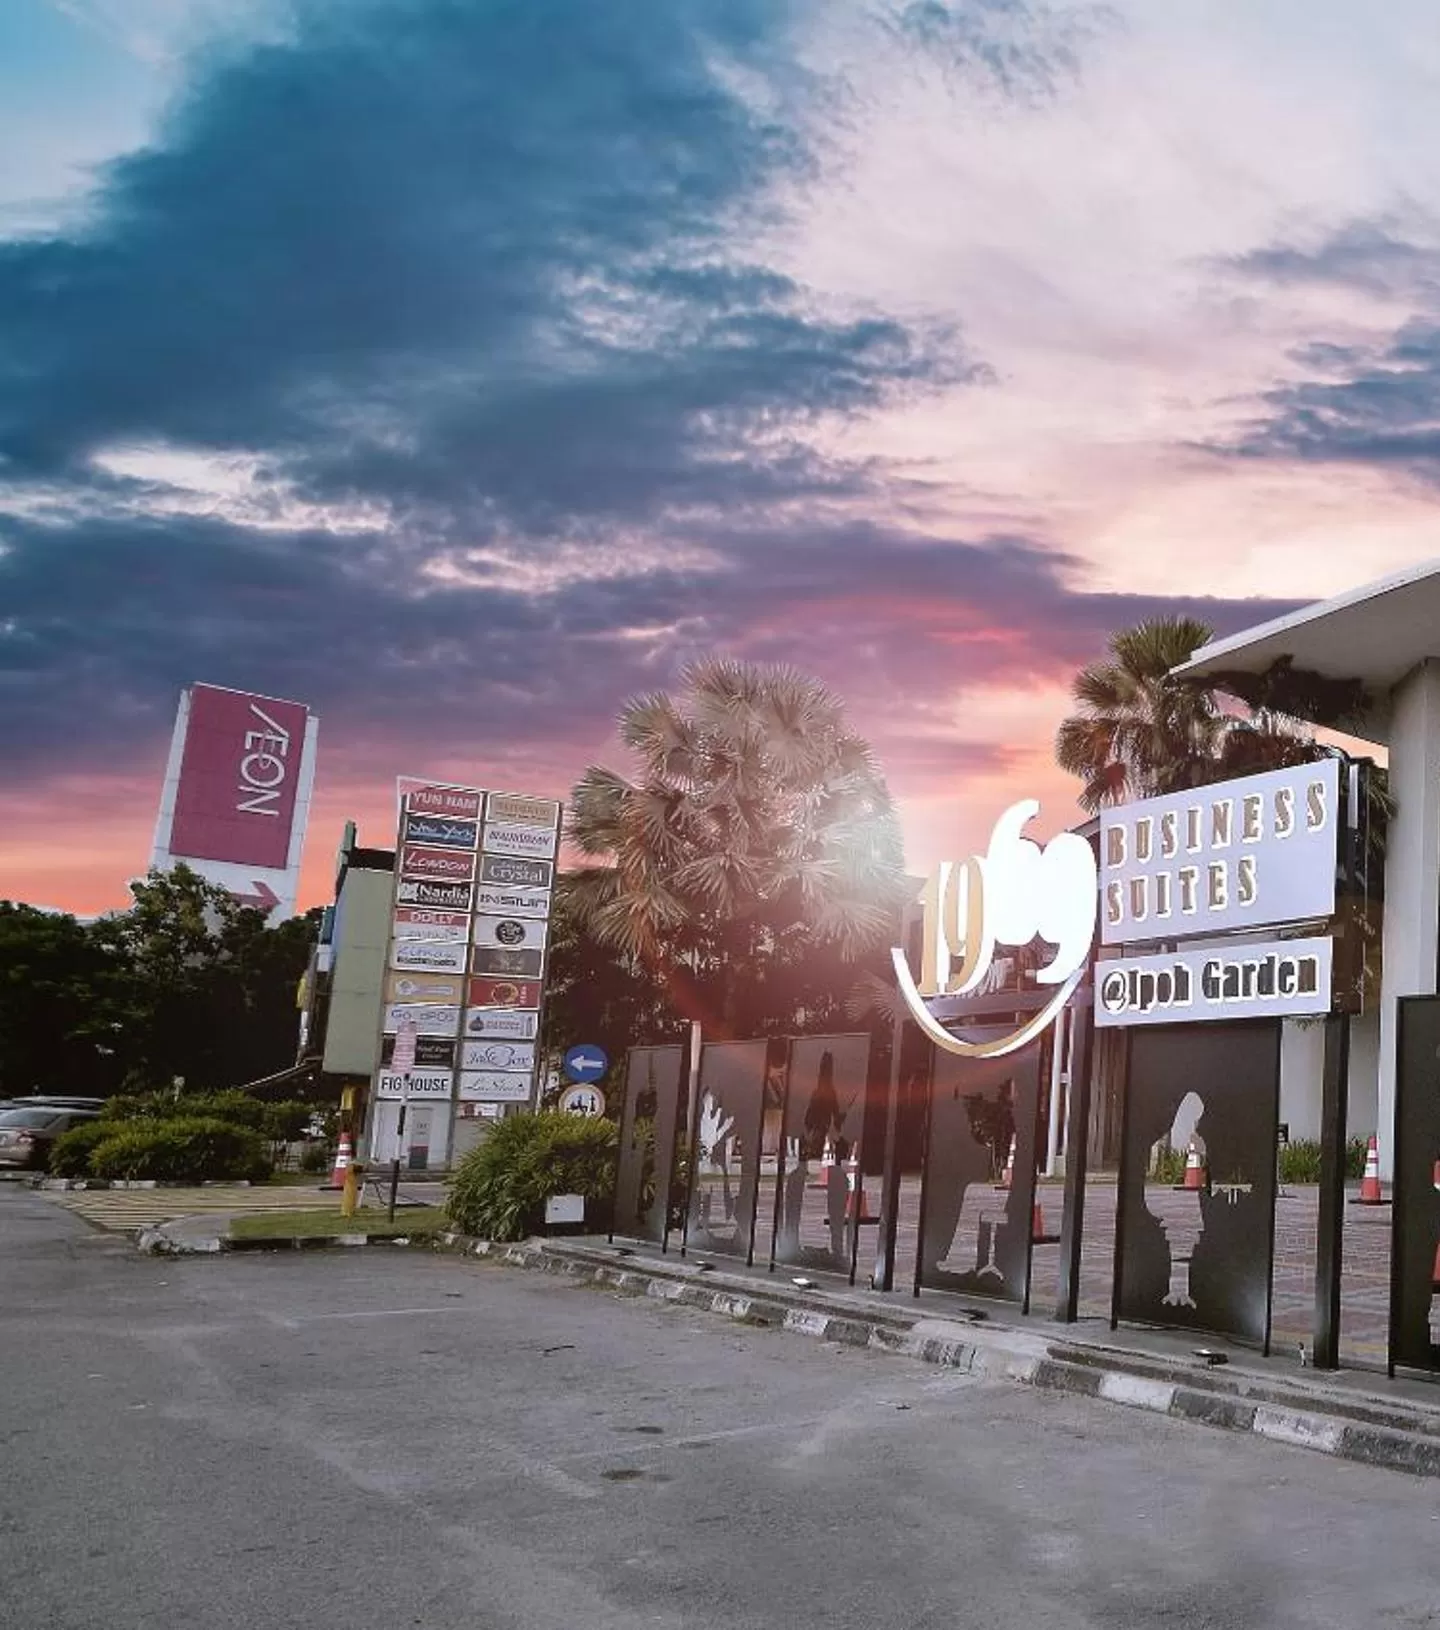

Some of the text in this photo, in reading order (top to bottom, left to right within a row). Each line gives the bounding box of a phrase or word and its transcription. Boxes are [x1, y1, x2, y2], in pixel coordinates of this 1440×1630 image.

[235, 703, 290, 817] AEON
[414, 792, 443, 806] YUN
[1106, 781, 1327, 869] BUSINESS
[490, 866, 543, 883] Crystal
[1106, 854, 1259, 925] SUITES
[410, 912, 455, 925] DOLLY
[1101, 952, 1319, 1013] @Ipoh Garden
[381, 1076, 402, 1091] FIG
[408, 1077, 449, 1092] HOUSE
